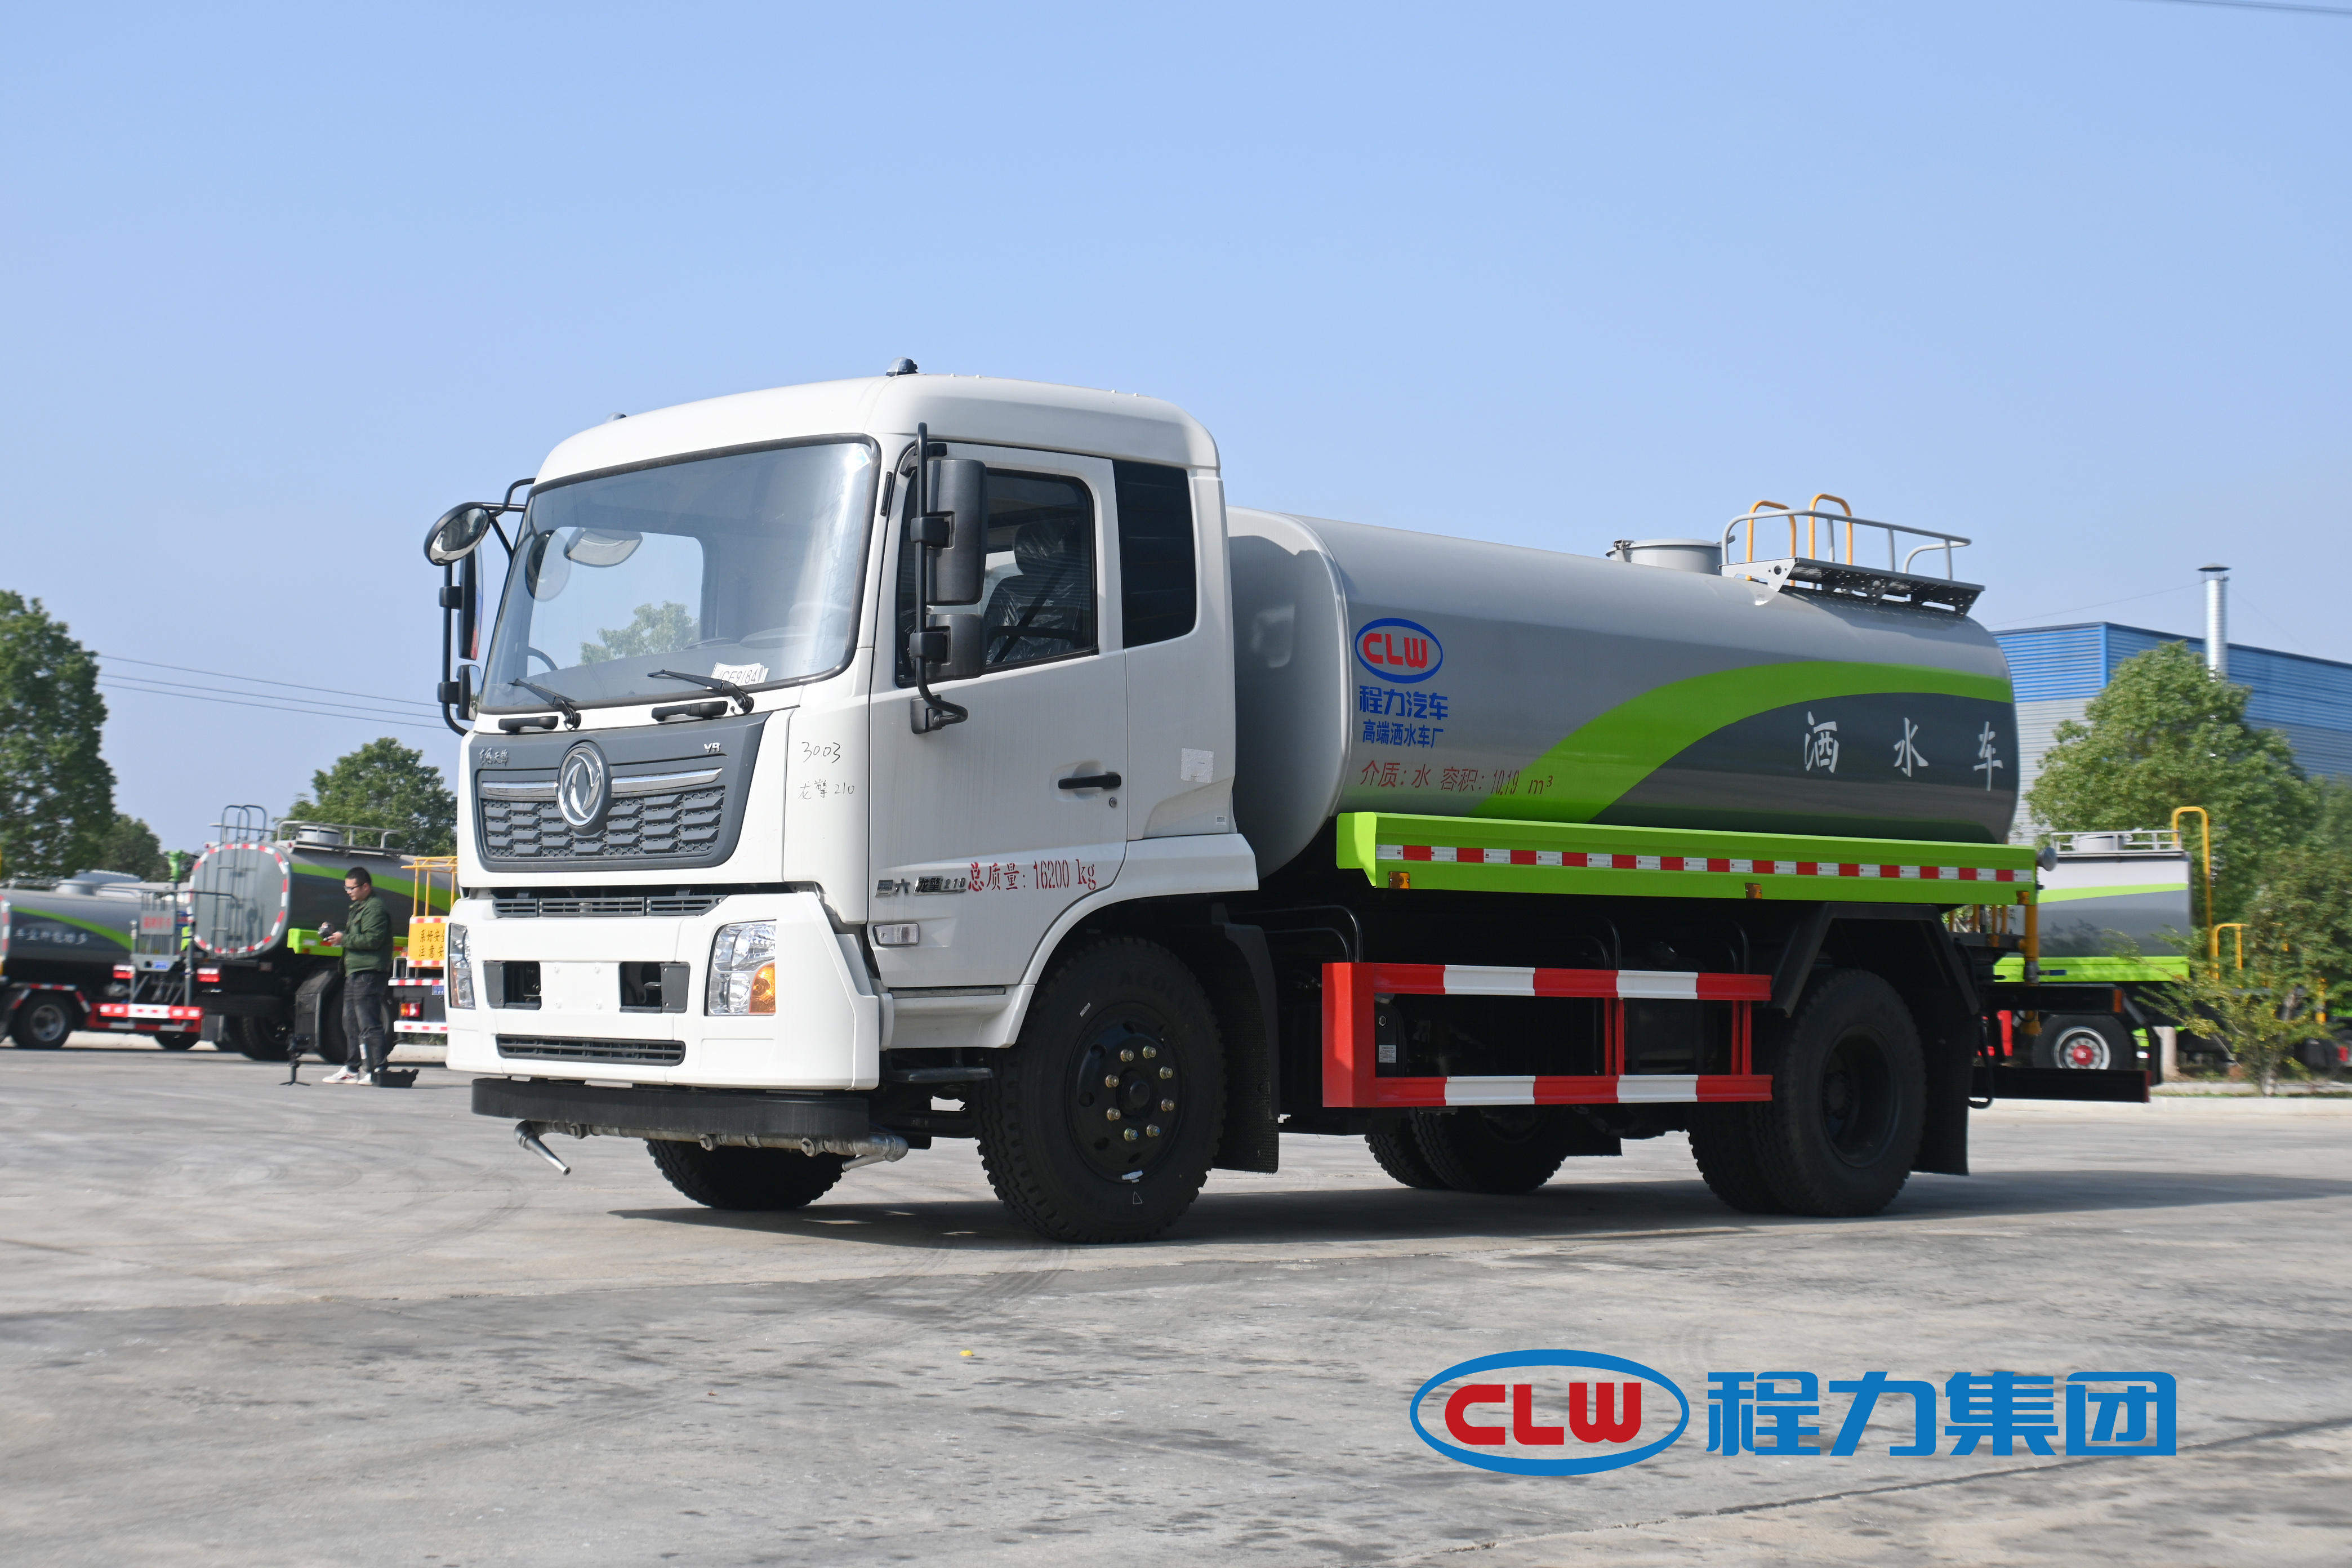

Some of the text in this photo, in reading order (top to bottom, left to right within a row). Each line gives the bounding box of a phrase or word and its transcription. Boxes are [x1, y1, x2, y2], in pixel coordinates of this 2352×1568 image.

[1363, 632, 1428, 669] CLW
[1359, 685, 1448, 720] 程力汽车
[704, 742, 721, 754] VR
[1362, 719, 1444, 749] 高端洒水车厂
[801, 741, 841, 764] 3003
[1805, 711, 2003, 792] 洒水车
[1077, 859, 1096, 890] kg
